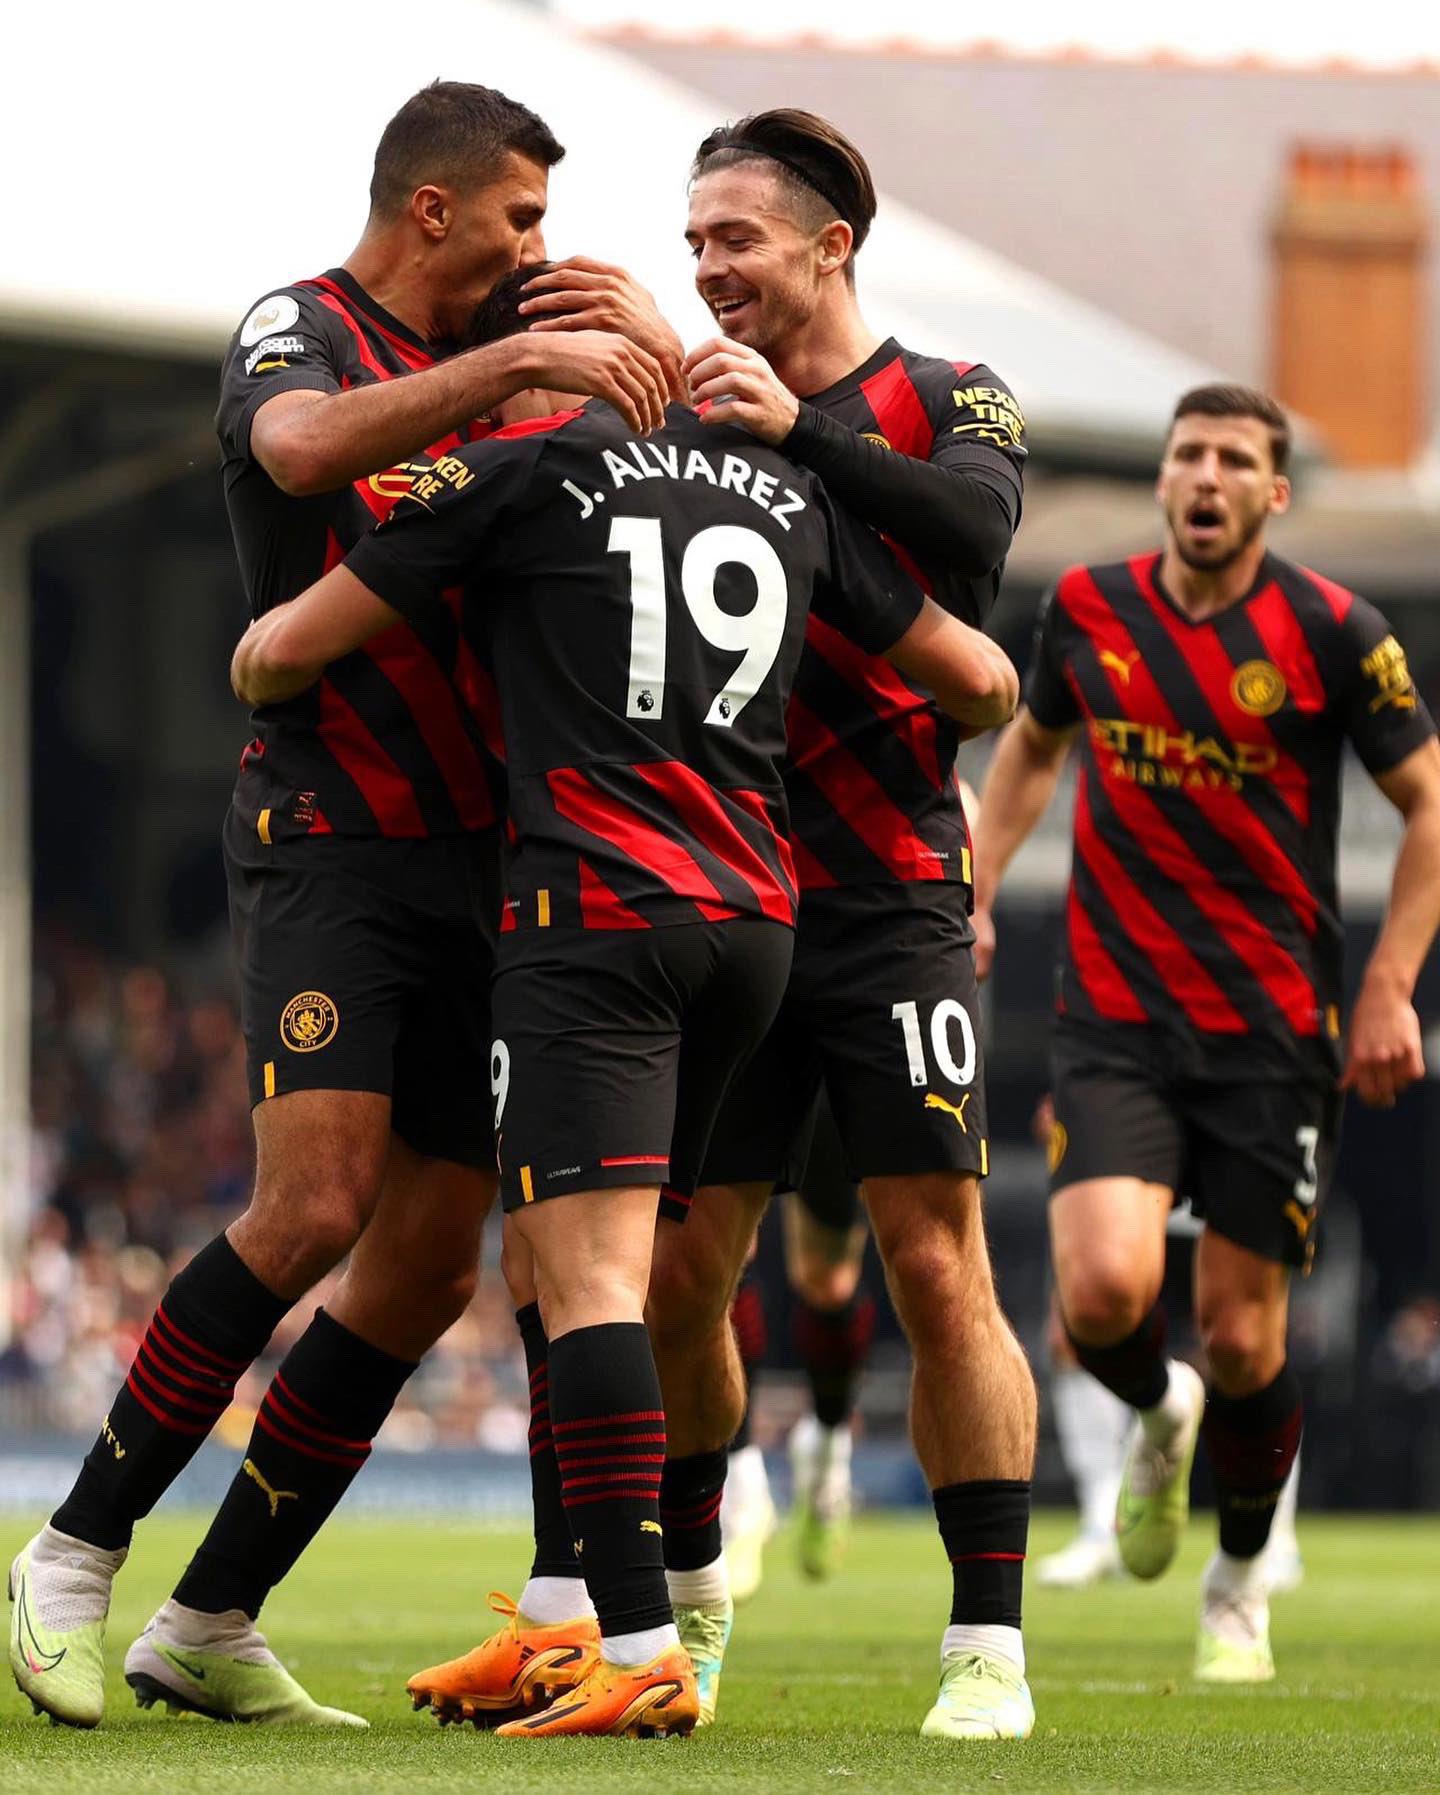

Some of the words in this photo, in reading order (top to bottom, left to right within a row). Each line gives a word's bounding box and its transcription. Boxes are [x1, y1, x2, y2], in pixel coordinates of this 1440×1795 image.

[562, 479, 605, 519] J.
[601, 441, 807, 531] ALVAREZ
[607, 516, 788, 727] 19
[285, 996, 331, 1019] MANCHESTER
[299, 1040, 317, 1048] CITY
[892, 999, 976, 1087] 10
[1295, 1126, 1319, 1206] 3
